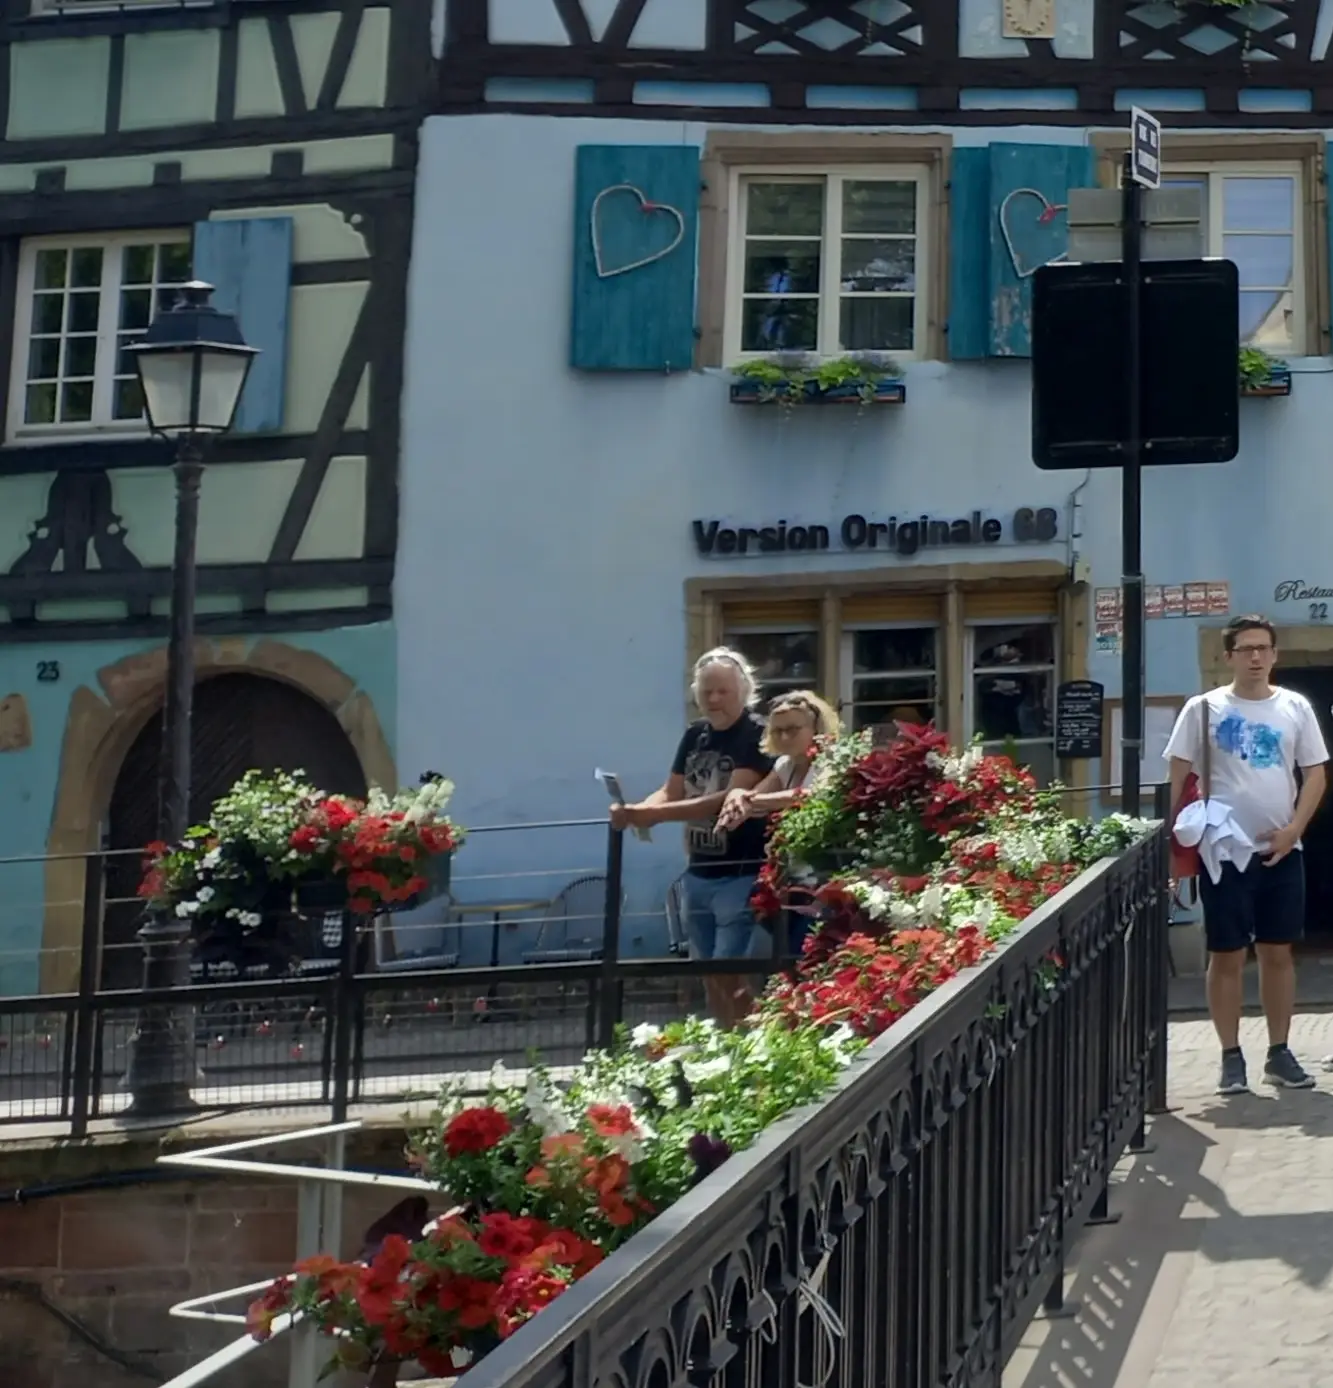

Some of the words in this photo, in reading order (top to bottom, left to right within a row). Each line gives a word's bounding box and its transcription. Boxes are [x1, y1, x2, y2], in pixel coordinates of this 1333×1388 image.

[692, 519, 829, 555] Version
[841, 511, 1002, 556] Originale
[1012, 508, 1058, 541] 68
[1309, 602, 1329, 620] 22
[36, 660, 60, 681] 23
